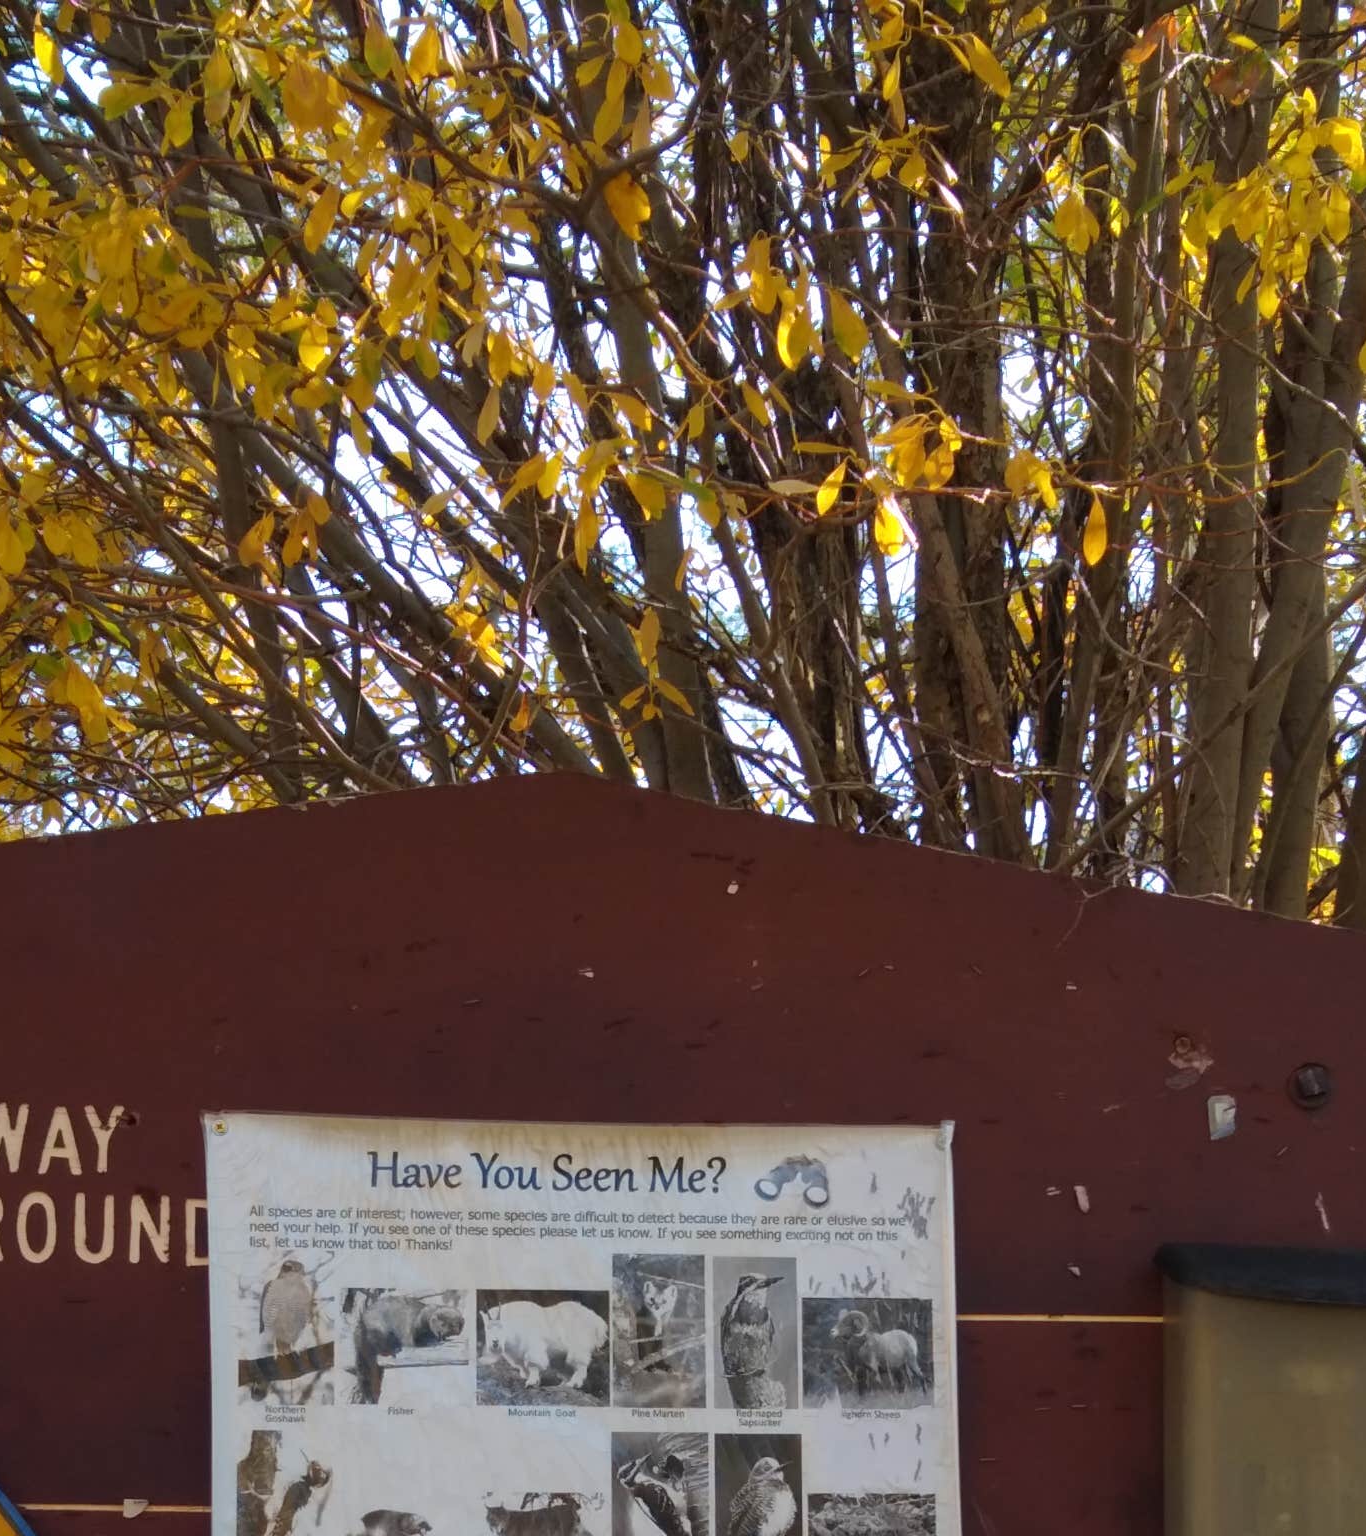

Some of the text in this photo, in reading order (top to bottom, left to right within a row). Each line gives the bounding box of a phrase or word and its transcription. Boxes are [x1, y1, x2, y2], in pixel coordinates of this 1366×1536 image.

[367, 1152, 727, 1193] Have You Seen Me?
[249, 1205, 905, 1227] All species are of interest; however, some species are difficult to detect because they are rare or elusive so we
[249, 1220, 898, 1243] need your help. If you see one of these species please let us know. If you see something exciting not on this
[249, 1236, 453, 1252] list, let us know that too! Thanks!
[387, 1407, 414, 1416] Fisher
[508, 1408, 576, 1418] Mountain Goat
[632, 1409, 685, 1418] Pine Marten
